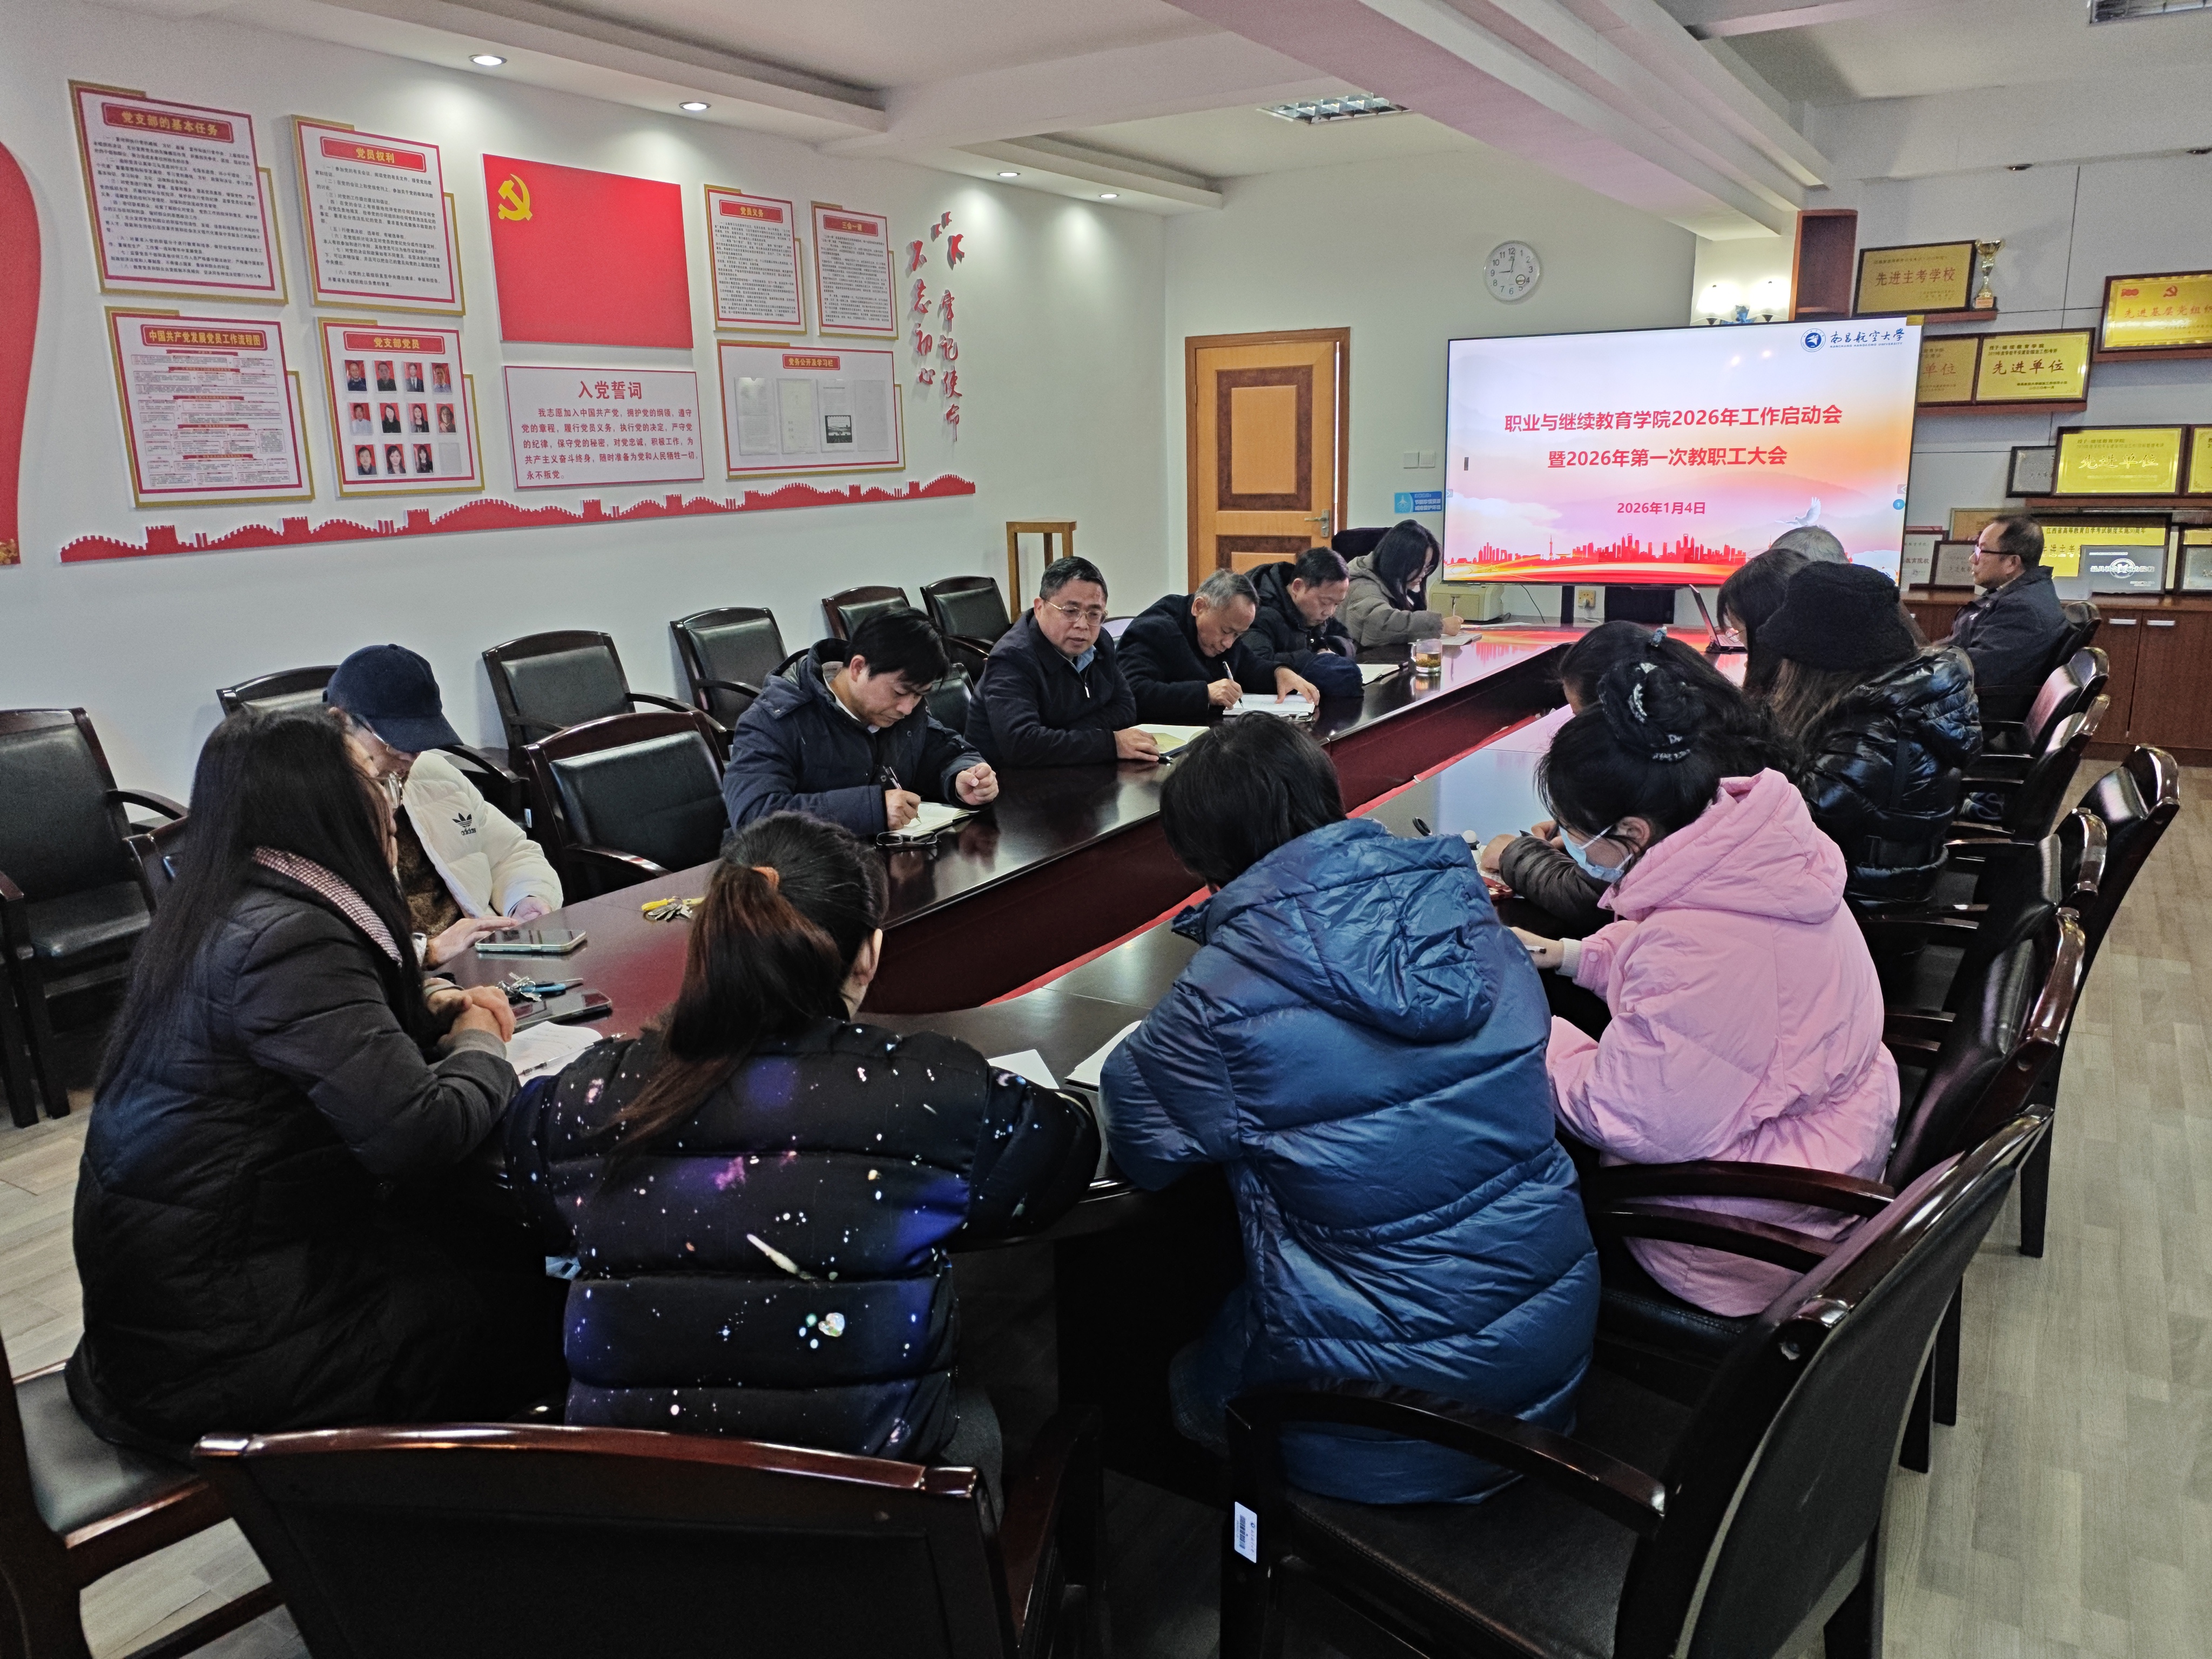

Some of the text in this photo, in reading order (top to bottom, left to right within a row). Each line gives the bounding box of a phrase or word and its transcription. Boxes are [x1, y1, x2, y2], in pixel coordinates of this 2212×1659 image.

[122, 110, 218, 136] 党支部的基本任务
[355, 147, 395, 164] 党员权利
[740, 206, 764, 218] 党员义务
[841, 221, 862, 232] 三会一课
[1875, 267, 1955, 287] 先进主考学校
[912, 240, 936, 385] 不忘初心
[2124, 305, 2212, 318] 先进基层党组织
[149, 330, 261, 346] 中国共产党发展党员工作流程图
[374, 337, 420, 349] 党支部党员
[1830, 328, 1905, 343] 南昌航空大学
[788, 358, 833, 367] 党务公开及学习栏
[940, 289, 962, 442] 牢记使命
[1923, 362, 1956, 377] 单位
[1992, 359, 2064, 375] 先进单位
[578, 381, 642, 400] 入党誓词
[538, 408, 692, 418] 我志愿加入中国共产党，拥护党的纲领，遵守
[1505, 404, 1843, 433] 职业与继续教育学院2026年工作启动会
[521, 422, 693, 433] 党的章程，履行党员义务，执行党的决定，严守党
[523, 437, 693, 449] 的纪律，保守党的秘密，对党忠诚，积极工作，为
[1548, 446, 1788, 468] 暨2026年第一次教职工大会
[2079, 454, 2159, 469] 先进单位
[527, 470, 564, 480] 永不叛党。
[1617, 502, 1706, 515] 2026年1月4日
[461, 828, 476, 836] adidas
